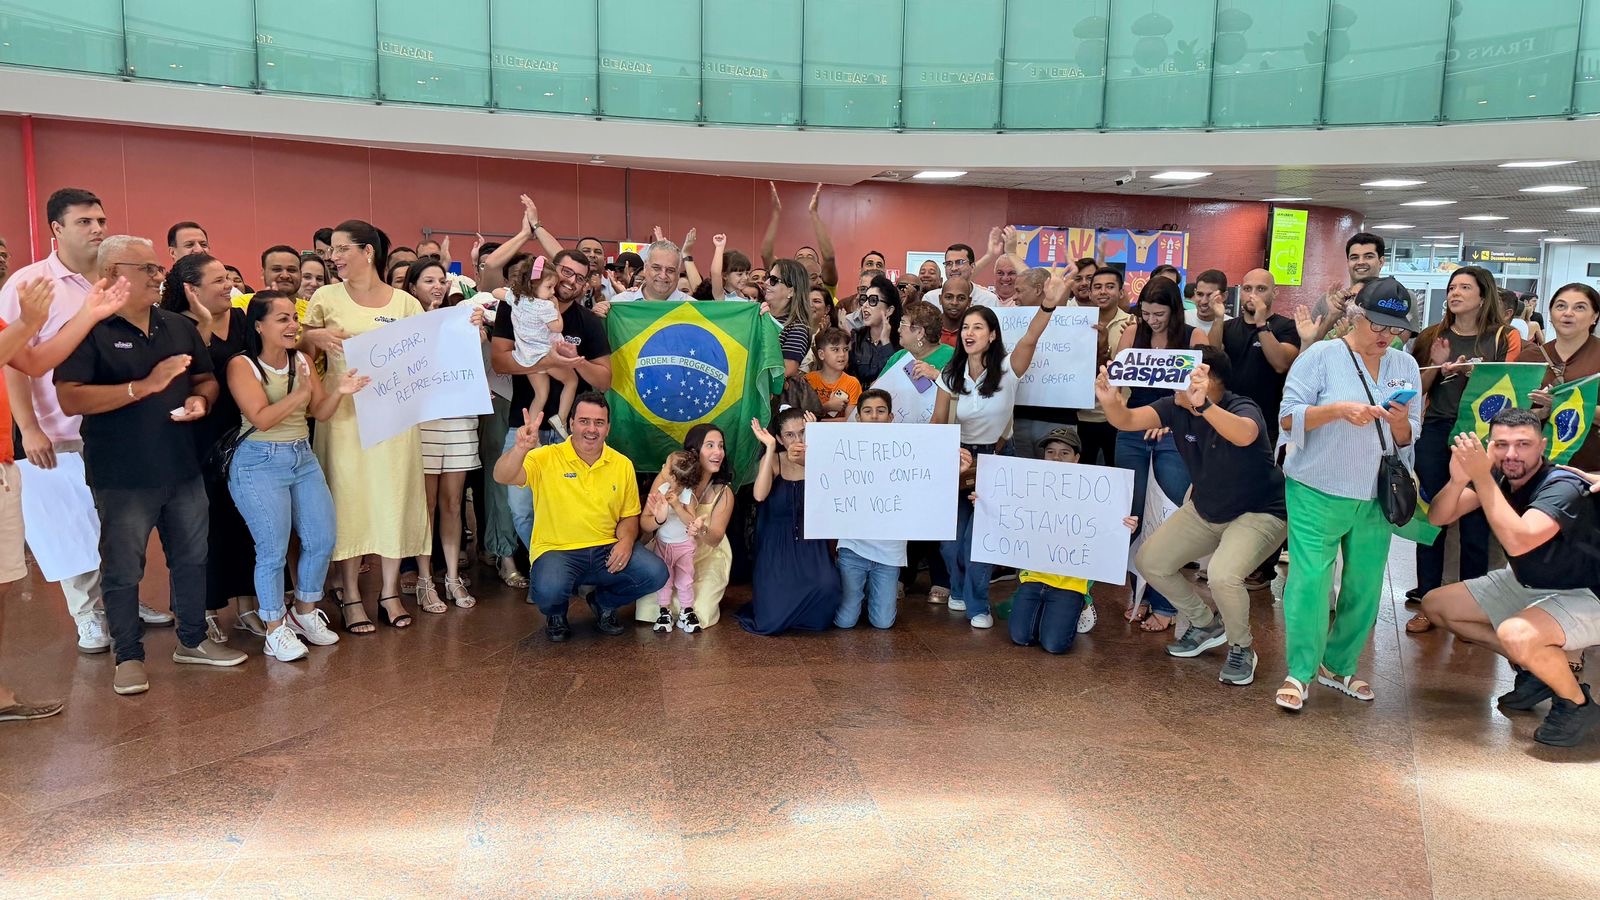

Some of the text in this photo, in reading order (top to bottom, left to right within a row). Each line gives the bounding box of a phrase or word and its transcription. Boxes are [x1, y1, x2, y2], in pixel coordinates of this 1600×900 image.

[369, 332, 426, 369] GASPAR,
[372, 356, 429, 397] VOCÊ NOS
[640, 357, 668, 366] ORDEM
[679, 358, 724, 380] PROGRESSO
[1107, 361, 1193, 386] Gaspar
[395, 369, 475, 404] REPRESENTA
[832, 439, 916, 463] ALFREDO,
[820, 468, 931, 490] O POVO CONFIA
[990, 467, 1112, 505] ALFREDO,
[834, 494, 903, 514] EM VOCÊ
[998, 504, 1097, 538] ESTAMOS
[982, 533, 1091, 566] COM VOCÊ
